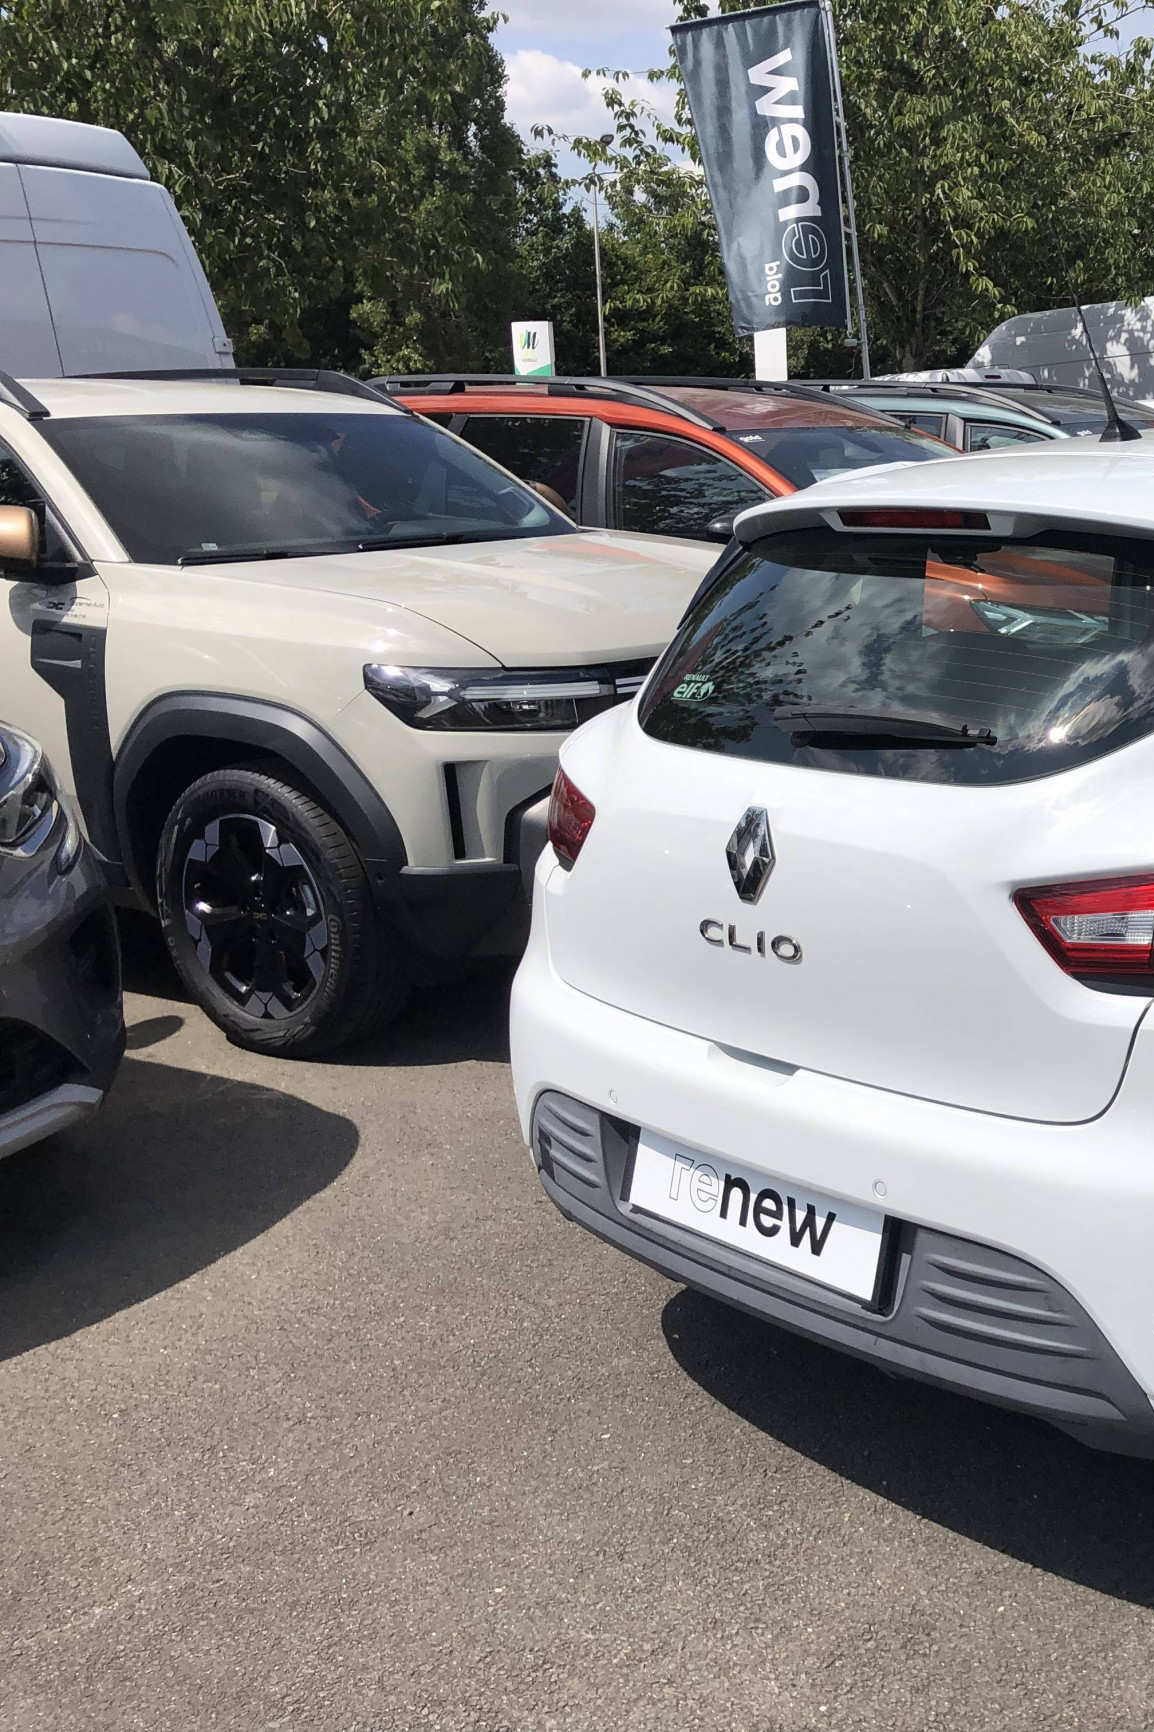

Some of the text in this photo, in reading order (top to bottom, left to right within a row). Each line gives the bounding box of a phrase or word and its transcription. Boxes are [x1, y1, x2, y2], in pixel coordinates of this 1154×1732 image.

[673, 682, 702, 698] elf
[699, 917, 803, 965] CLIO
[669, 1153, 837, 1257] renew
